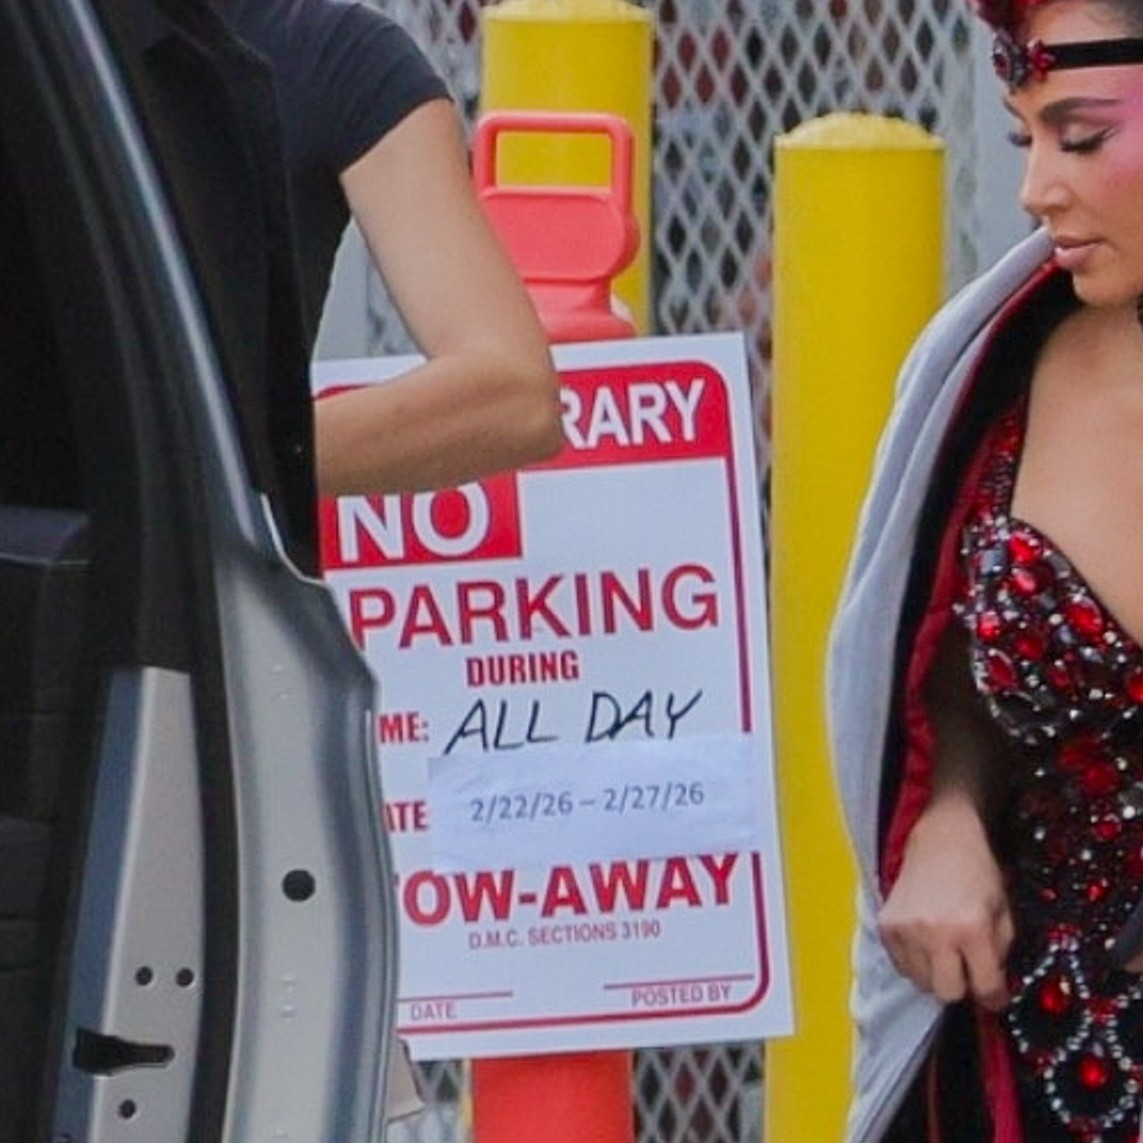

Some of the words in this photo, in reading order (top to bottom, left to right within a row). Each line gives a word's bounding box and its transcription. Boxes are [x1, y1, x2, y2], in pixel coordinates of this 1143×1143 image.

[336, 482, 490, 563] NO
[349, 564, 720, 650] PARKING
[466, 651, 580, 687] DURING
[444, 698, 558, 754] ALL
[584, 690, 703, 743] DAY
[470, 791, 573, 823] 2/22/26
[602, 782, 705, 813] 2/27/26
[393, 852, 739, 926] OW-AWAY
[528, 921, 616, 946] SECTIONS
[411, 1002, 457, 1021] DATE
[631, 987, 702, 1007] POSTED
[707, 984, 732, 1002] BY
